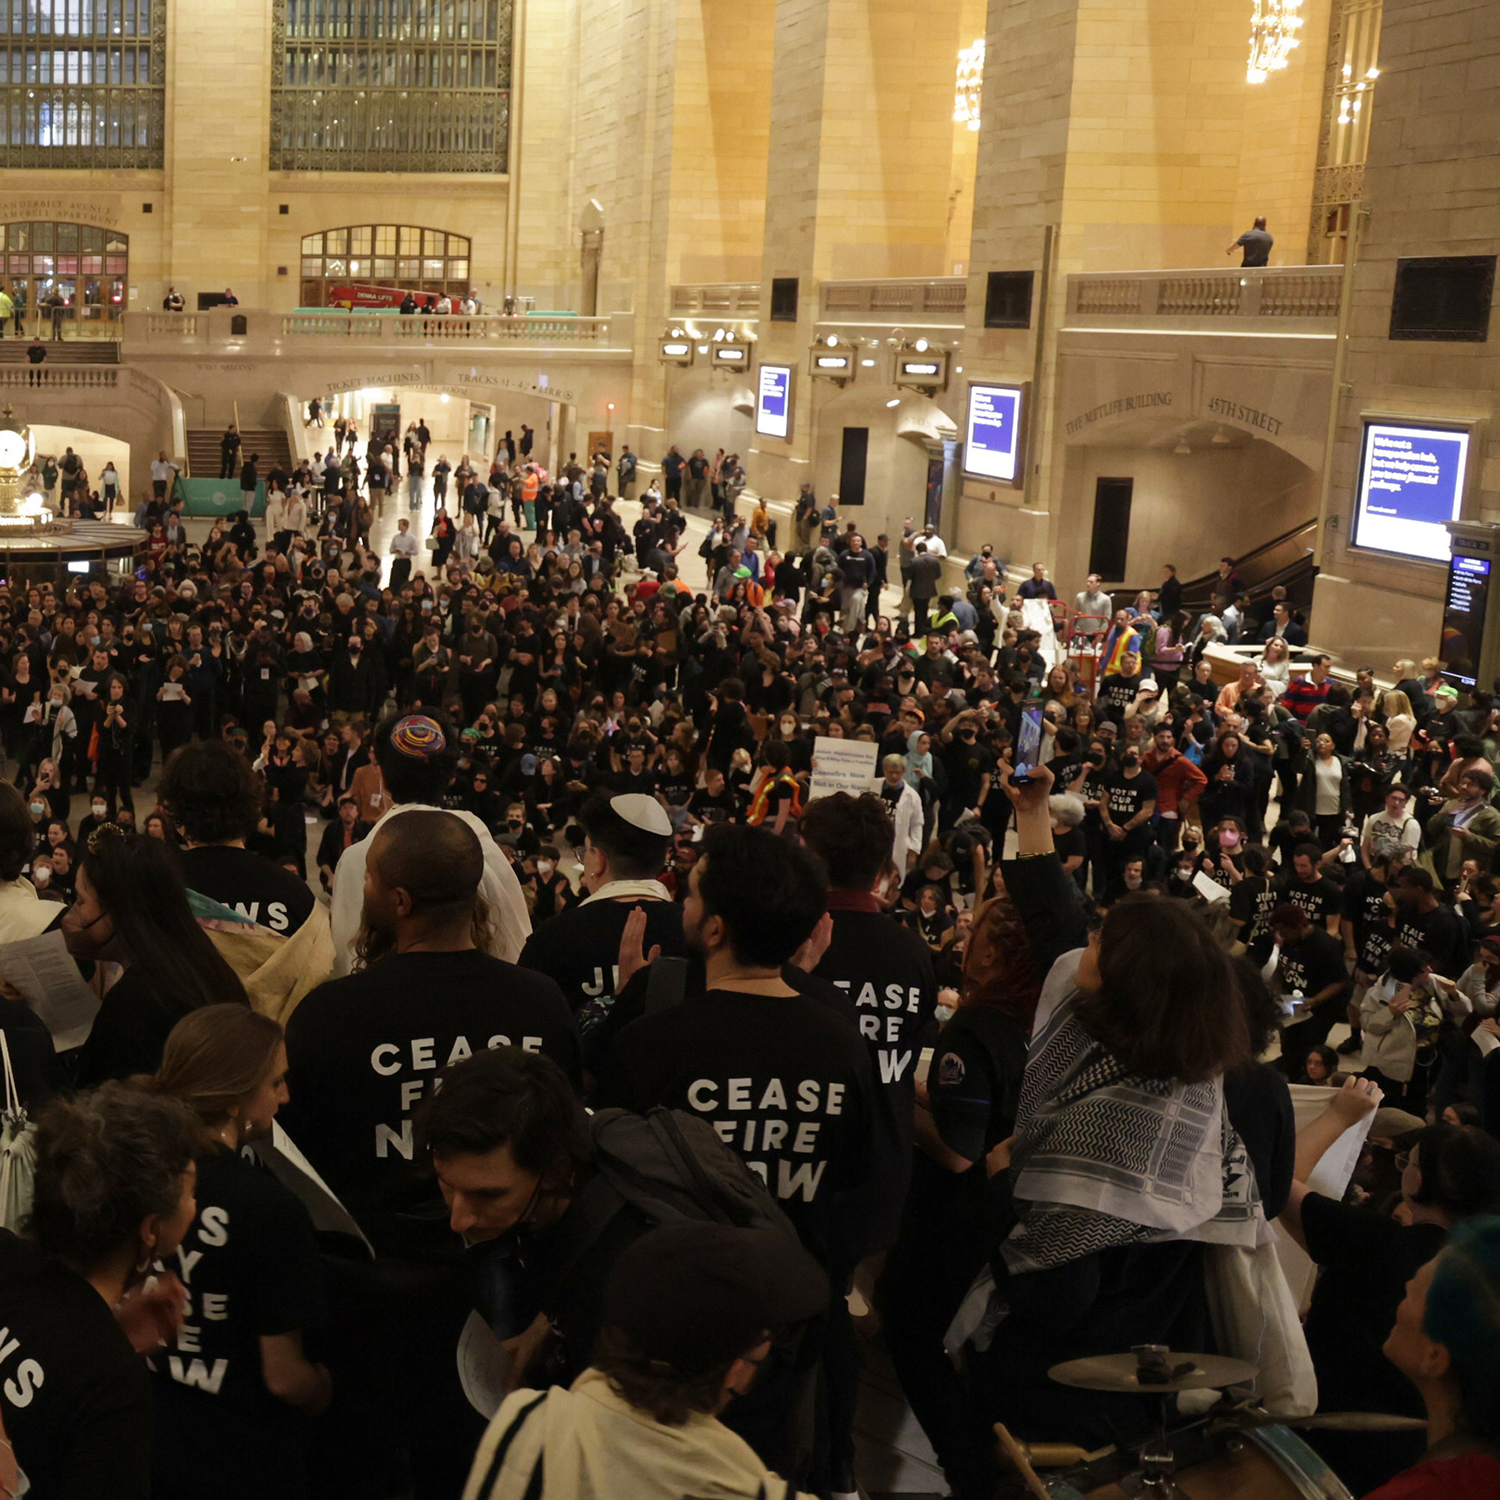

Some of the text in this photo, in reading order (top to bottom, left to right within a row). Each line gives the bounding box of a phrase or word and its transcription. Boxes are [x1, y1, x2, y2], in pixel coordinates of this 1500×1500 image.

[326, 372, 421, 391] TICKET MACHINES
[457, 373, 499, 386] TRACKS
[1065, 391, 1173, 436] THE METLIFE BUILDING
[1207, 396, 1284, 437] 45TH STREET
[814, 780, 827, 788] Not
[1112, 794, 1132, 805] OUR
[1288, 890, 1323, 905] NOT IN
[1291, 898, 1317, 912] OUR
[859, 1014, 904, 1043] RE
[687, 1077, 846, 1116] CEASE
[712, 1119, 821, 1154] FIRE
